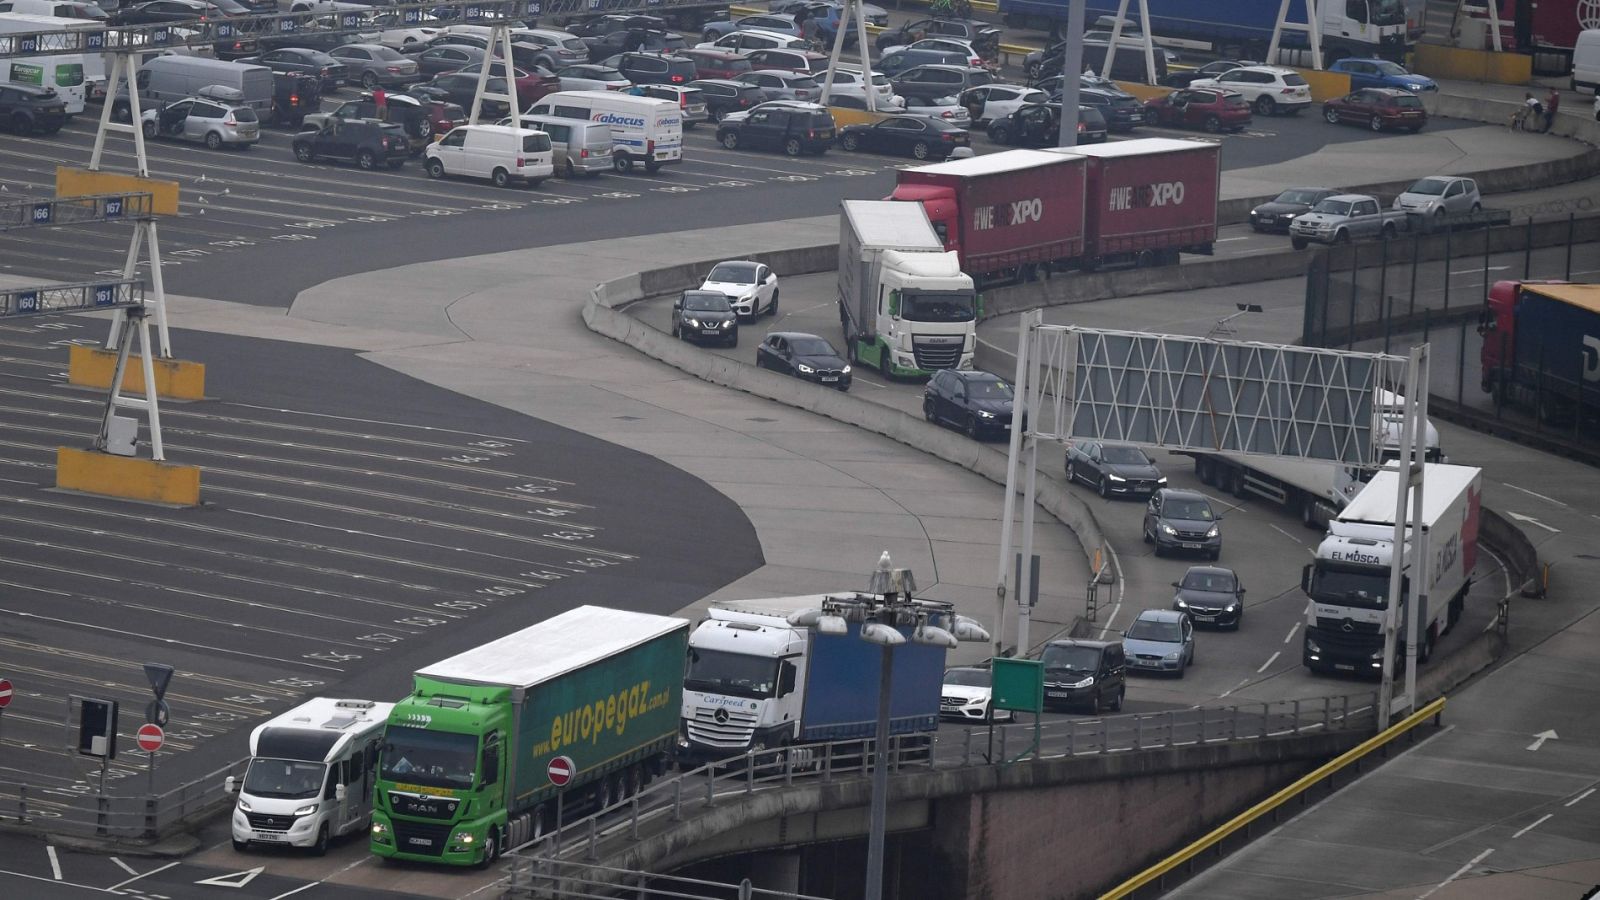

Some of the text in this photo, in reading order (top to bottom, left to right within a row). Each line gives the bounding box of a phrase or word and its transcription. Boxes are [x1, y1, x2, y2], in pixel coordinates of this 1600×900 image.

[467, 8, 479, 17] 185
[528, 4, 540, 13] 186
[343, 15, 356, 26] 183
[405, 11, 418, 22] 184
[218, 25, 230, 36] 181
[280, 20, 293, 31] 182
[88, 35, 101, 46] 179
[153, 30, 166, 41] 180
[21, 40, 35, 50] 178
[14, 65, 40, 74] Europcar
[600, 113, 645, 127] abacus
[34, 208, 48, 219] 166
[106, 202, 120, 214] 167
[96, 290, 110, 302] 161
[19, 297, 34, 309] 160
[1332, 551, 1380, 564] EL MOSCA
[704, 695, 745, 708] Carspeed
[408, 803, 438, 813] MAN
